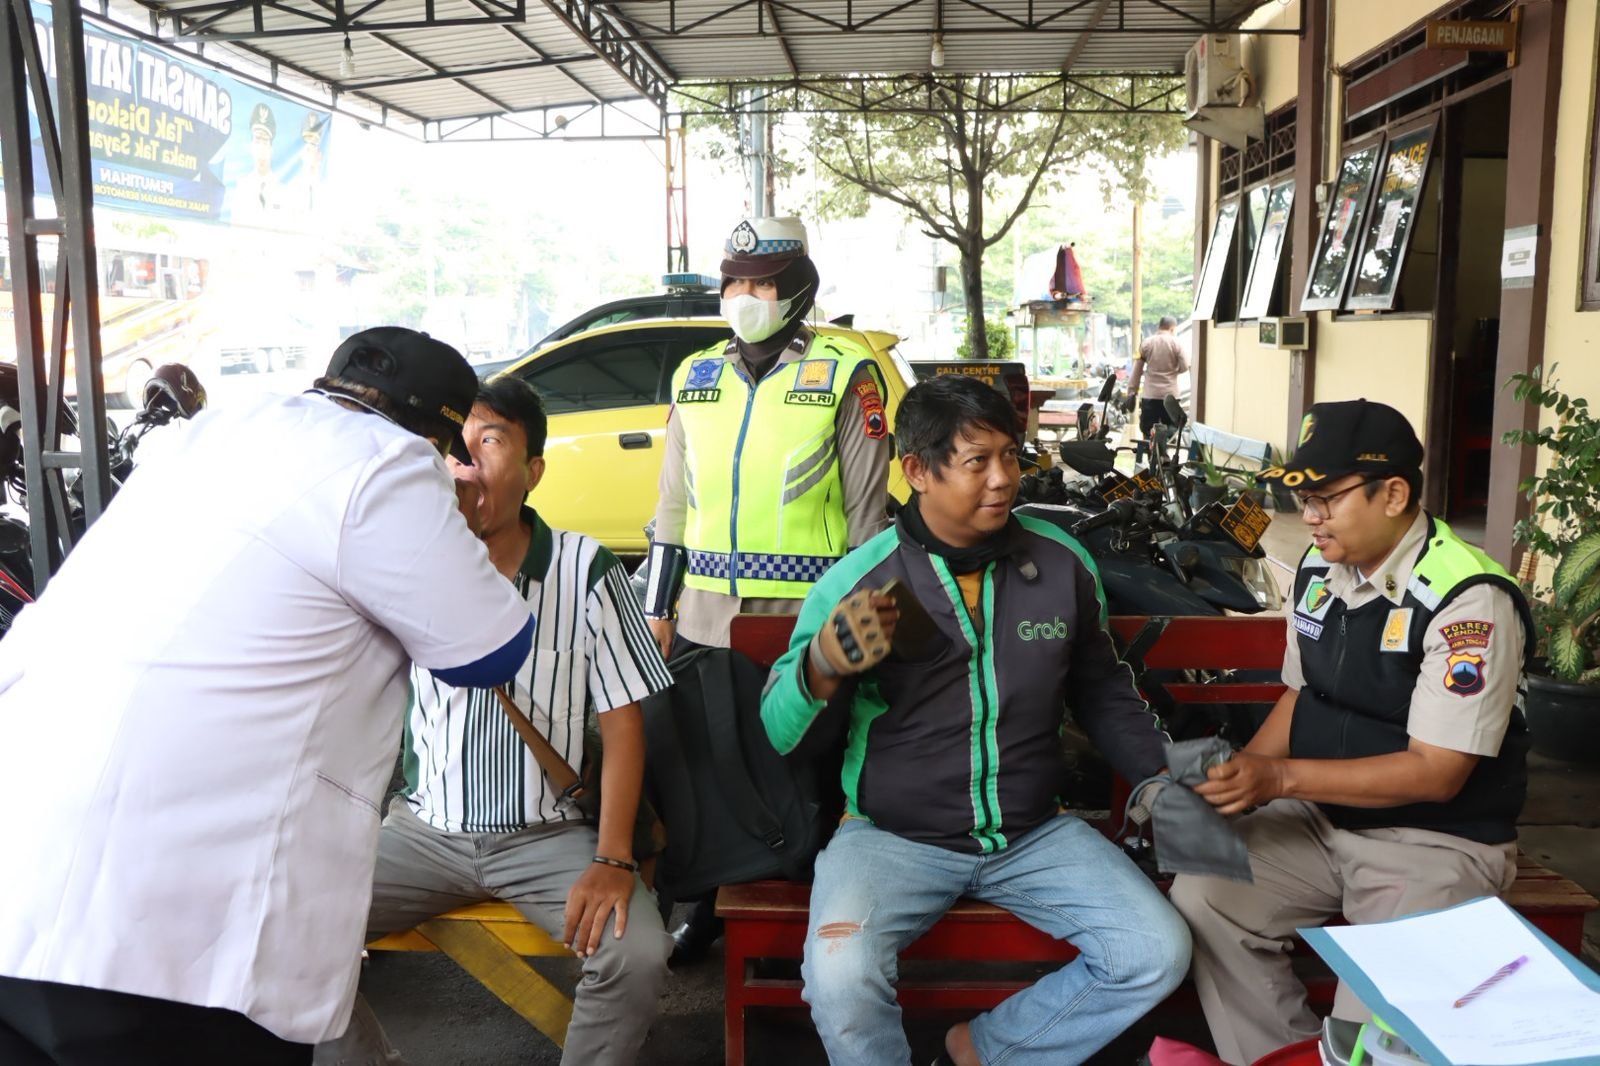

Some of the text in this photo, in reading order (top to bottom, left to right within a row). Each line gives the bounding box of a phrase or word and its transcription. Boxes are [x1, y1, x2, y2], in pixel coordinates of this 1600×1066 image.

[1437, 26, 1504, 45] PENJAGAAN
[936, 367, 960, 377] CALL
[789, 394, 831, 404] POLRI
[1017, 616, 1068, 641] Grab
[1443, 622, 1488, 634] POLRES
[1447, 629, 1486, 639] KENDAL
